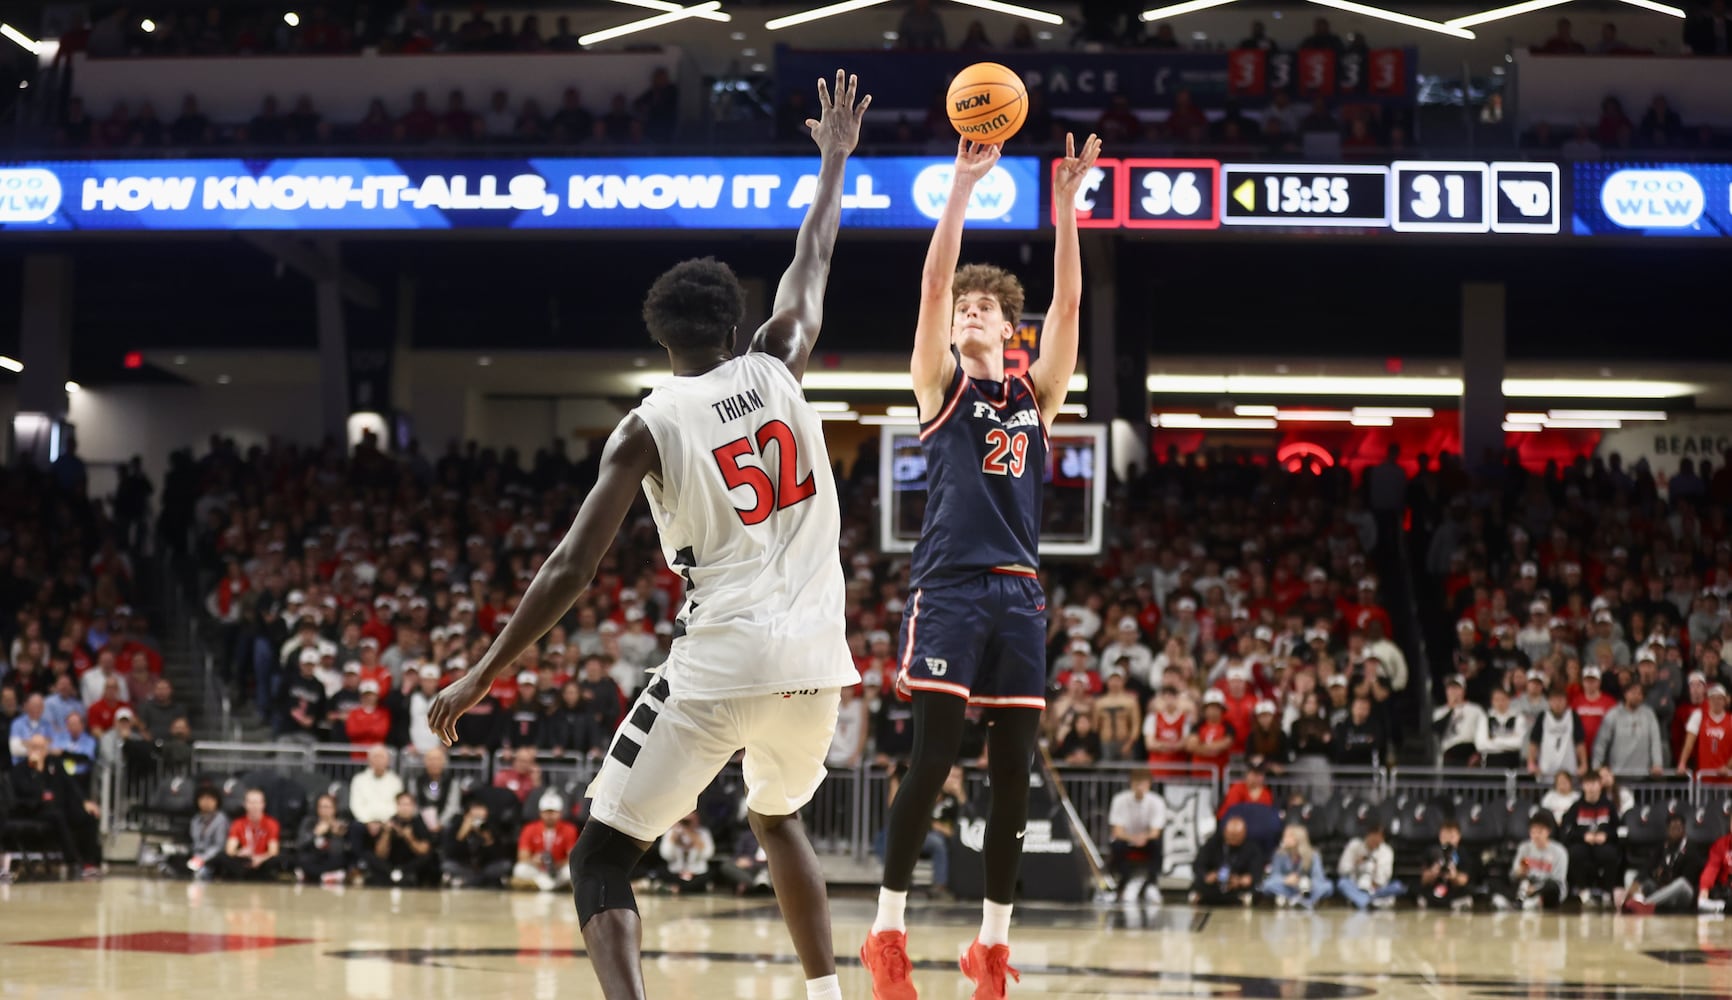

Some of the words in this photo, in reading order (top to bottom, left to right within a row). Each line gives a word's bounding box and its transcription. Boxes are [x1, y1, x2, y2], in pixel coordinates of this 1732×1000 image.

[1023, 69, 1120, 94] PACE
[955, 93, 991, 113] NCAA
[959, 113, 1009, 135] Wilson
[0, 176, 43, 191] OO
[938, 171, 996, 186] TO
[1625, 179, 1684, 193] TOO
[0, 194, 49, 211] LW
[82, 176, 196, 211] HOW
[203, 174, 559, 216] KNOW-IT-ALLS,
[568, 174, 724, 209] KNOW
[732, 174, 781, 209] IT
[787, 174, 891, 209] AL
[926, 191, 1003, 208] WW
[1141, 171, 1201, 215] 36
[1264, 176, 1349, 213] 15:55
[1411, 174, 1465, 218] 31
[1616, 198, 1692, 215] WLW
[711, 388, 765, 424] THIAM
[973, 401, 1039, 429] FLERS
[982, 428, 1029, 478] 29
[712, 419, 817, 526] 52
